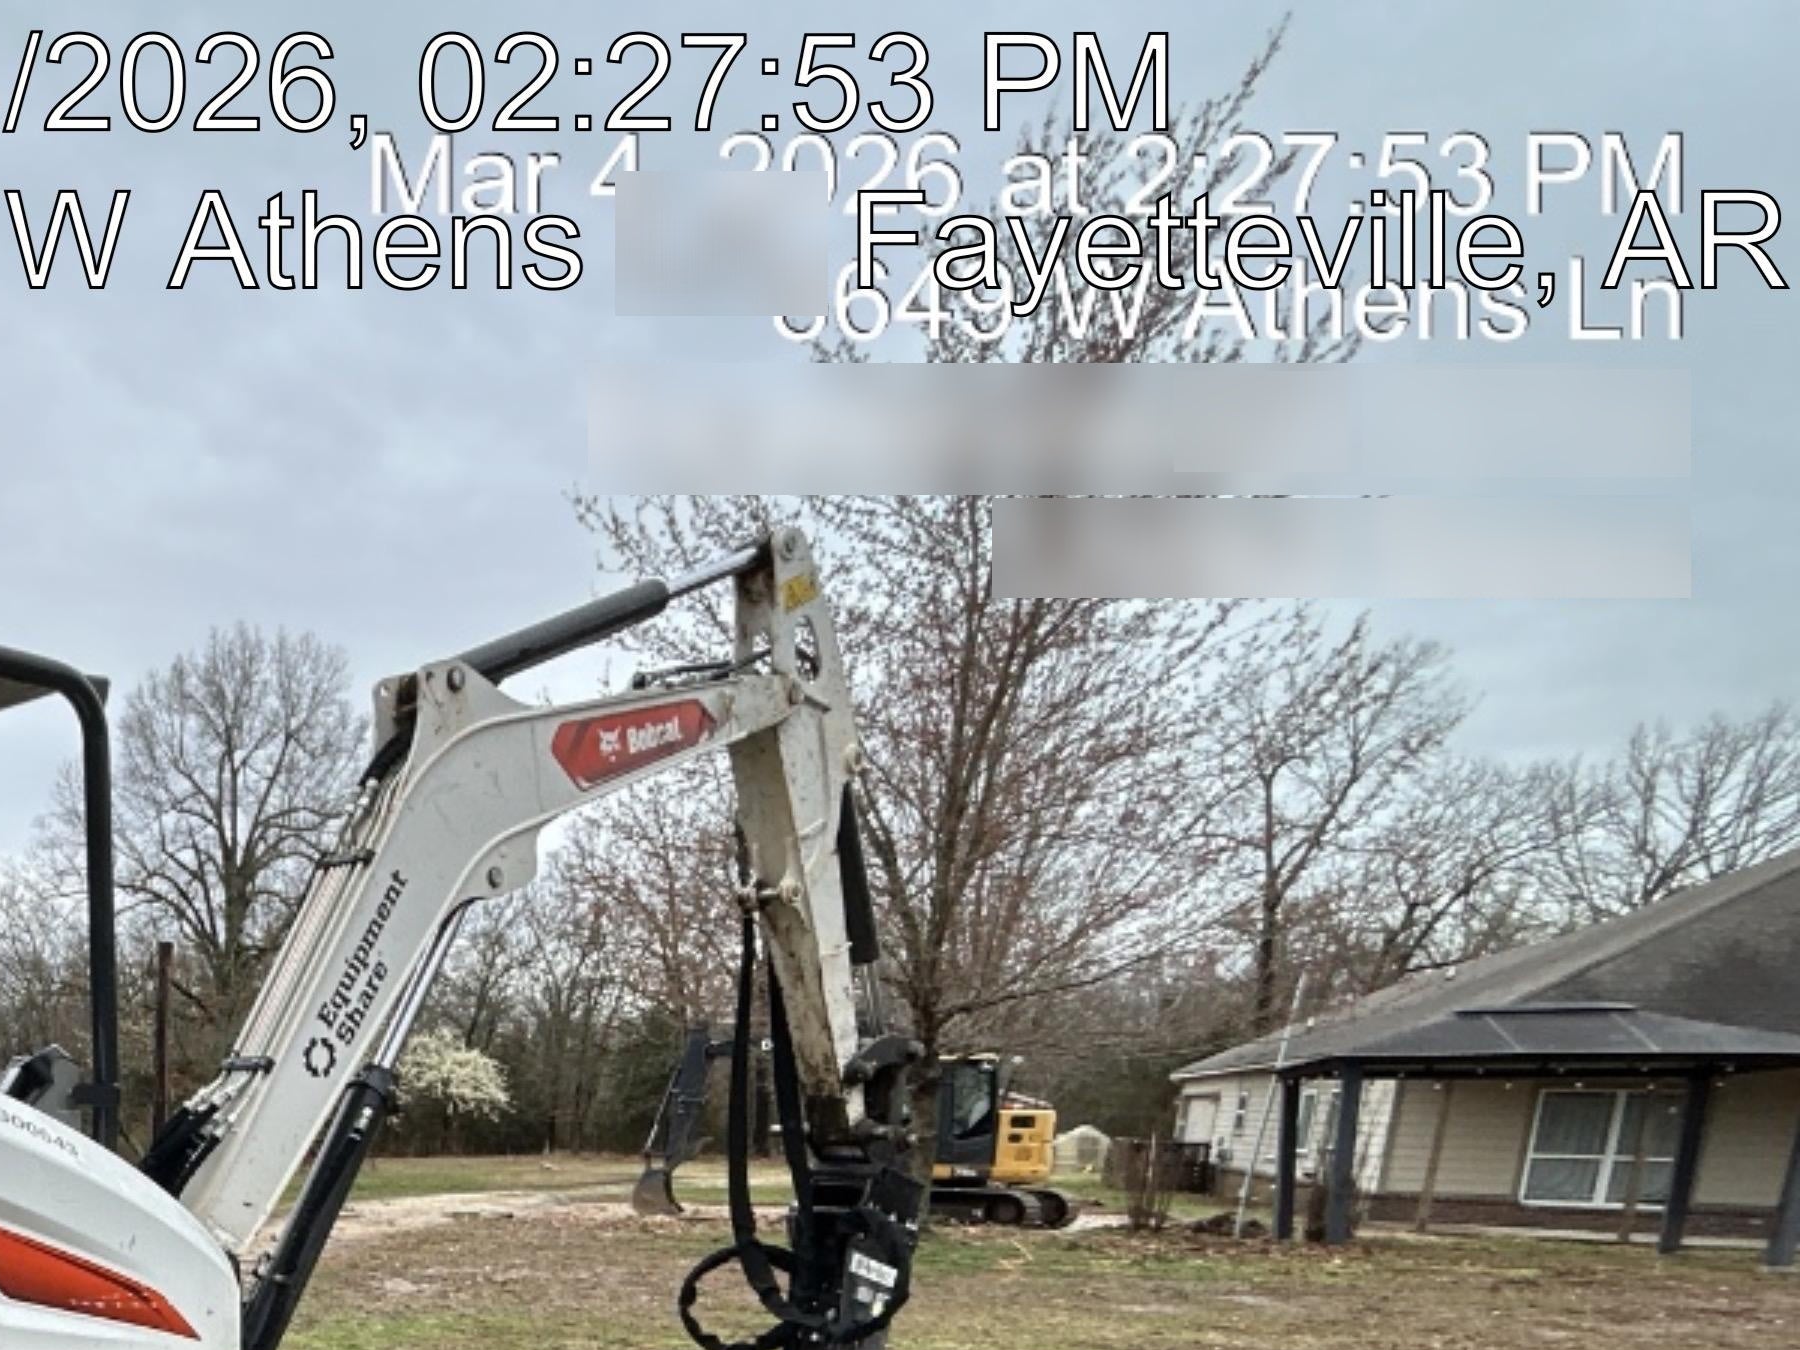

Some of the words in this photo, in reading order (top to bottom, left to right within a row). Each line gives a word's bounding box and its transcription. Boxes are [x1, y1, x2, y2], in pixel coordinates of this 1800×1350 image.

[625, 715, 683, 755] Bobcat
[316, 868, 409, 1029] Equipment
[335, 959, 389, 1046] Share
